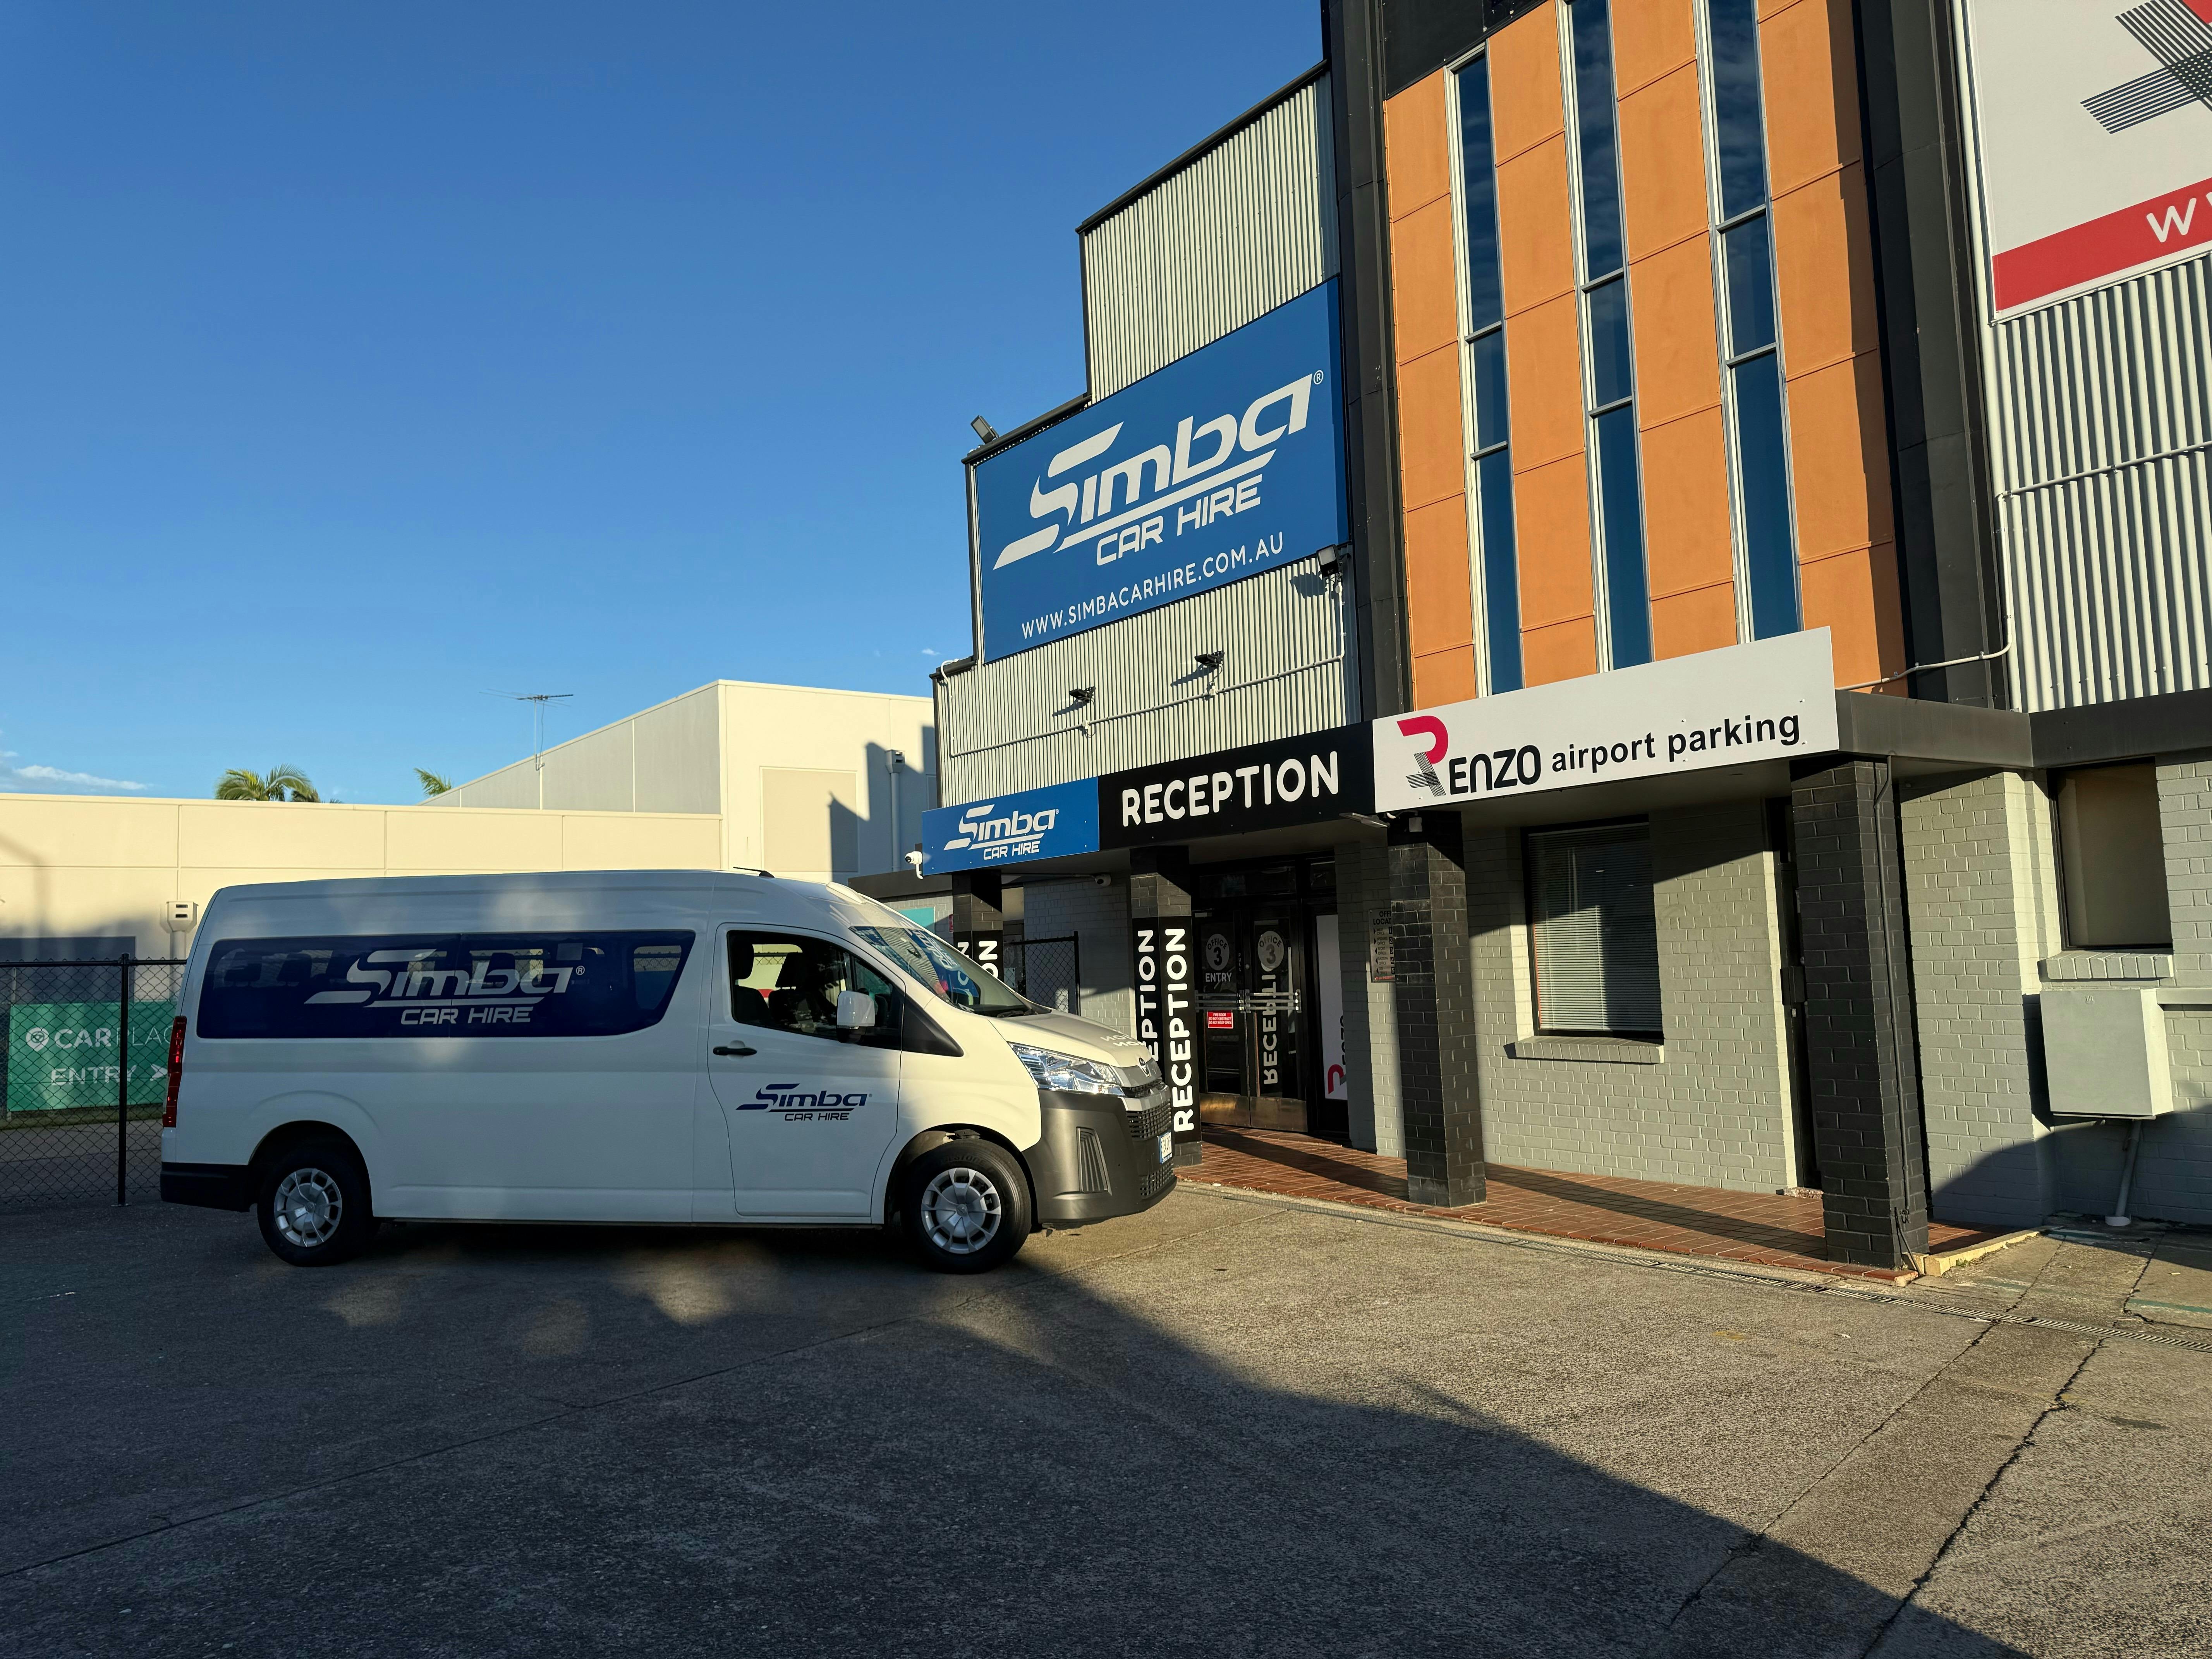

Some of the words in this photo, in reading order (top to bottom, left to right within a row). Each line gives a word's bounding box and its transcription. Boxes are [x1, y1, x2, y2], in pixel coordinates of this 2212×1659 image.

[2146, 191, 2212, 243] W
[1096, 516, 1163, 566] CAR
[1177, 474, 1262, 536] HIRE
[1022, 531, 1283, 639] WWW.SIMBACARHIRE.COM.AU
[1552, 732, 1656, 774] airport
[1668, 714, 1800, 763] parking
[1122, 751, 1339, 827] RECEPTION
[983, 846, 1008, 860] CAR
[1012, 840, 1041, 857] HIRE
[1207, 938, 1228, 950] OFFICE
[1259, 936, 1282, 947] OFFICE
[1213, 946, 1223, 966] 3
[1266, 944, 1276, 964] 3
[1205, 972, 1232, 982] ENTRY
[1137, 930, 1159, 1061] EPTION
[400, 1008, 457, 1025] CAR
[467, 1006, 534, 1024] HIRE
[54, 1026, 174, 1049] CARPLAC
[1165, 928, 1194, 1132] RECEPTION
[51, 1064, 137, 1086] ENTRY
[785, 1113, 813, 1121] CAR
[818, 1112, 850, 1121] HIRE
